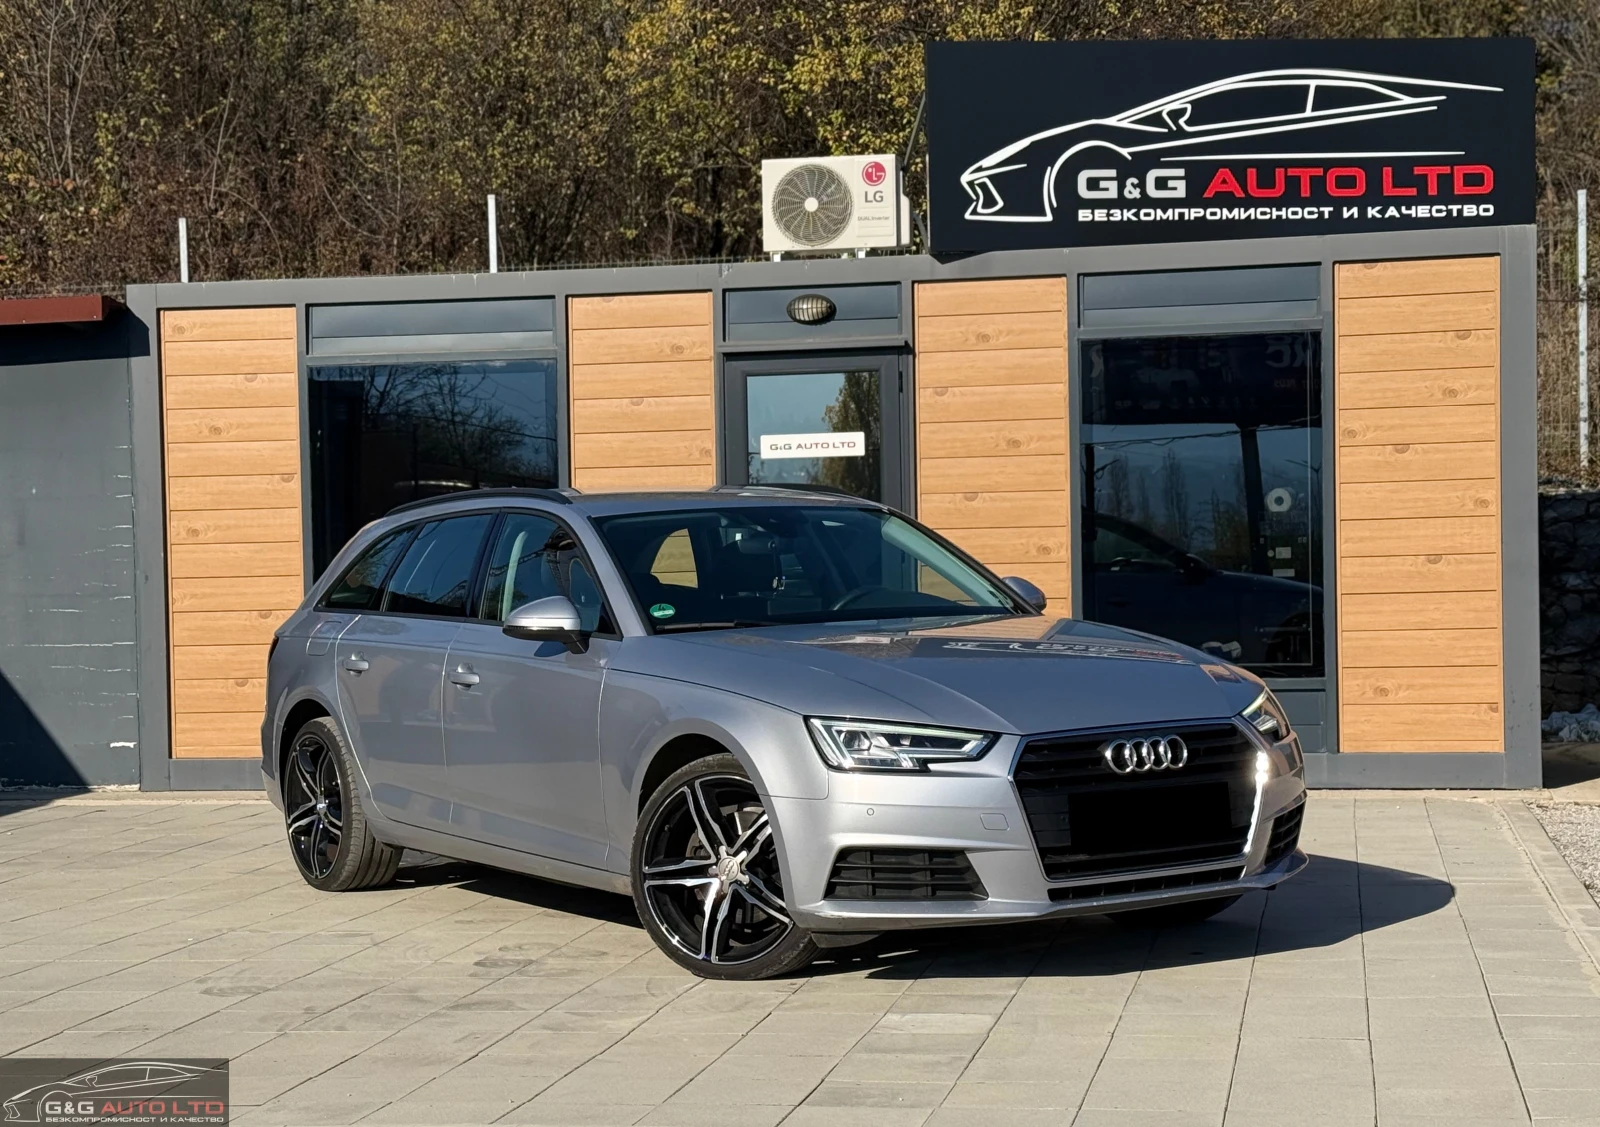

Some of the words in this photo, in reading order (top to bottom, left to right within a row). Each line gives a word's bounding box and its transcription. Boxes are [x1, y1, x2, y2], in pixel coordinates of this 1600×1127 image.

[1077, 168, 1187, 199] G&G
[1202, 166, 1367, 198] AUTO
[1382, 164, 1495, 197] LTD
[864, 190, 884, 203] LG
[1077, 206, 1334, 222] БЕЗКОМПРОМИСНОСТ
[1342, 206, 1359, 219] И
[1367, 203, 1495, 219] КАЧЕСТВО
[796, 442, 830, 450] AUTO
[832, 441, 856, 449] LTD
